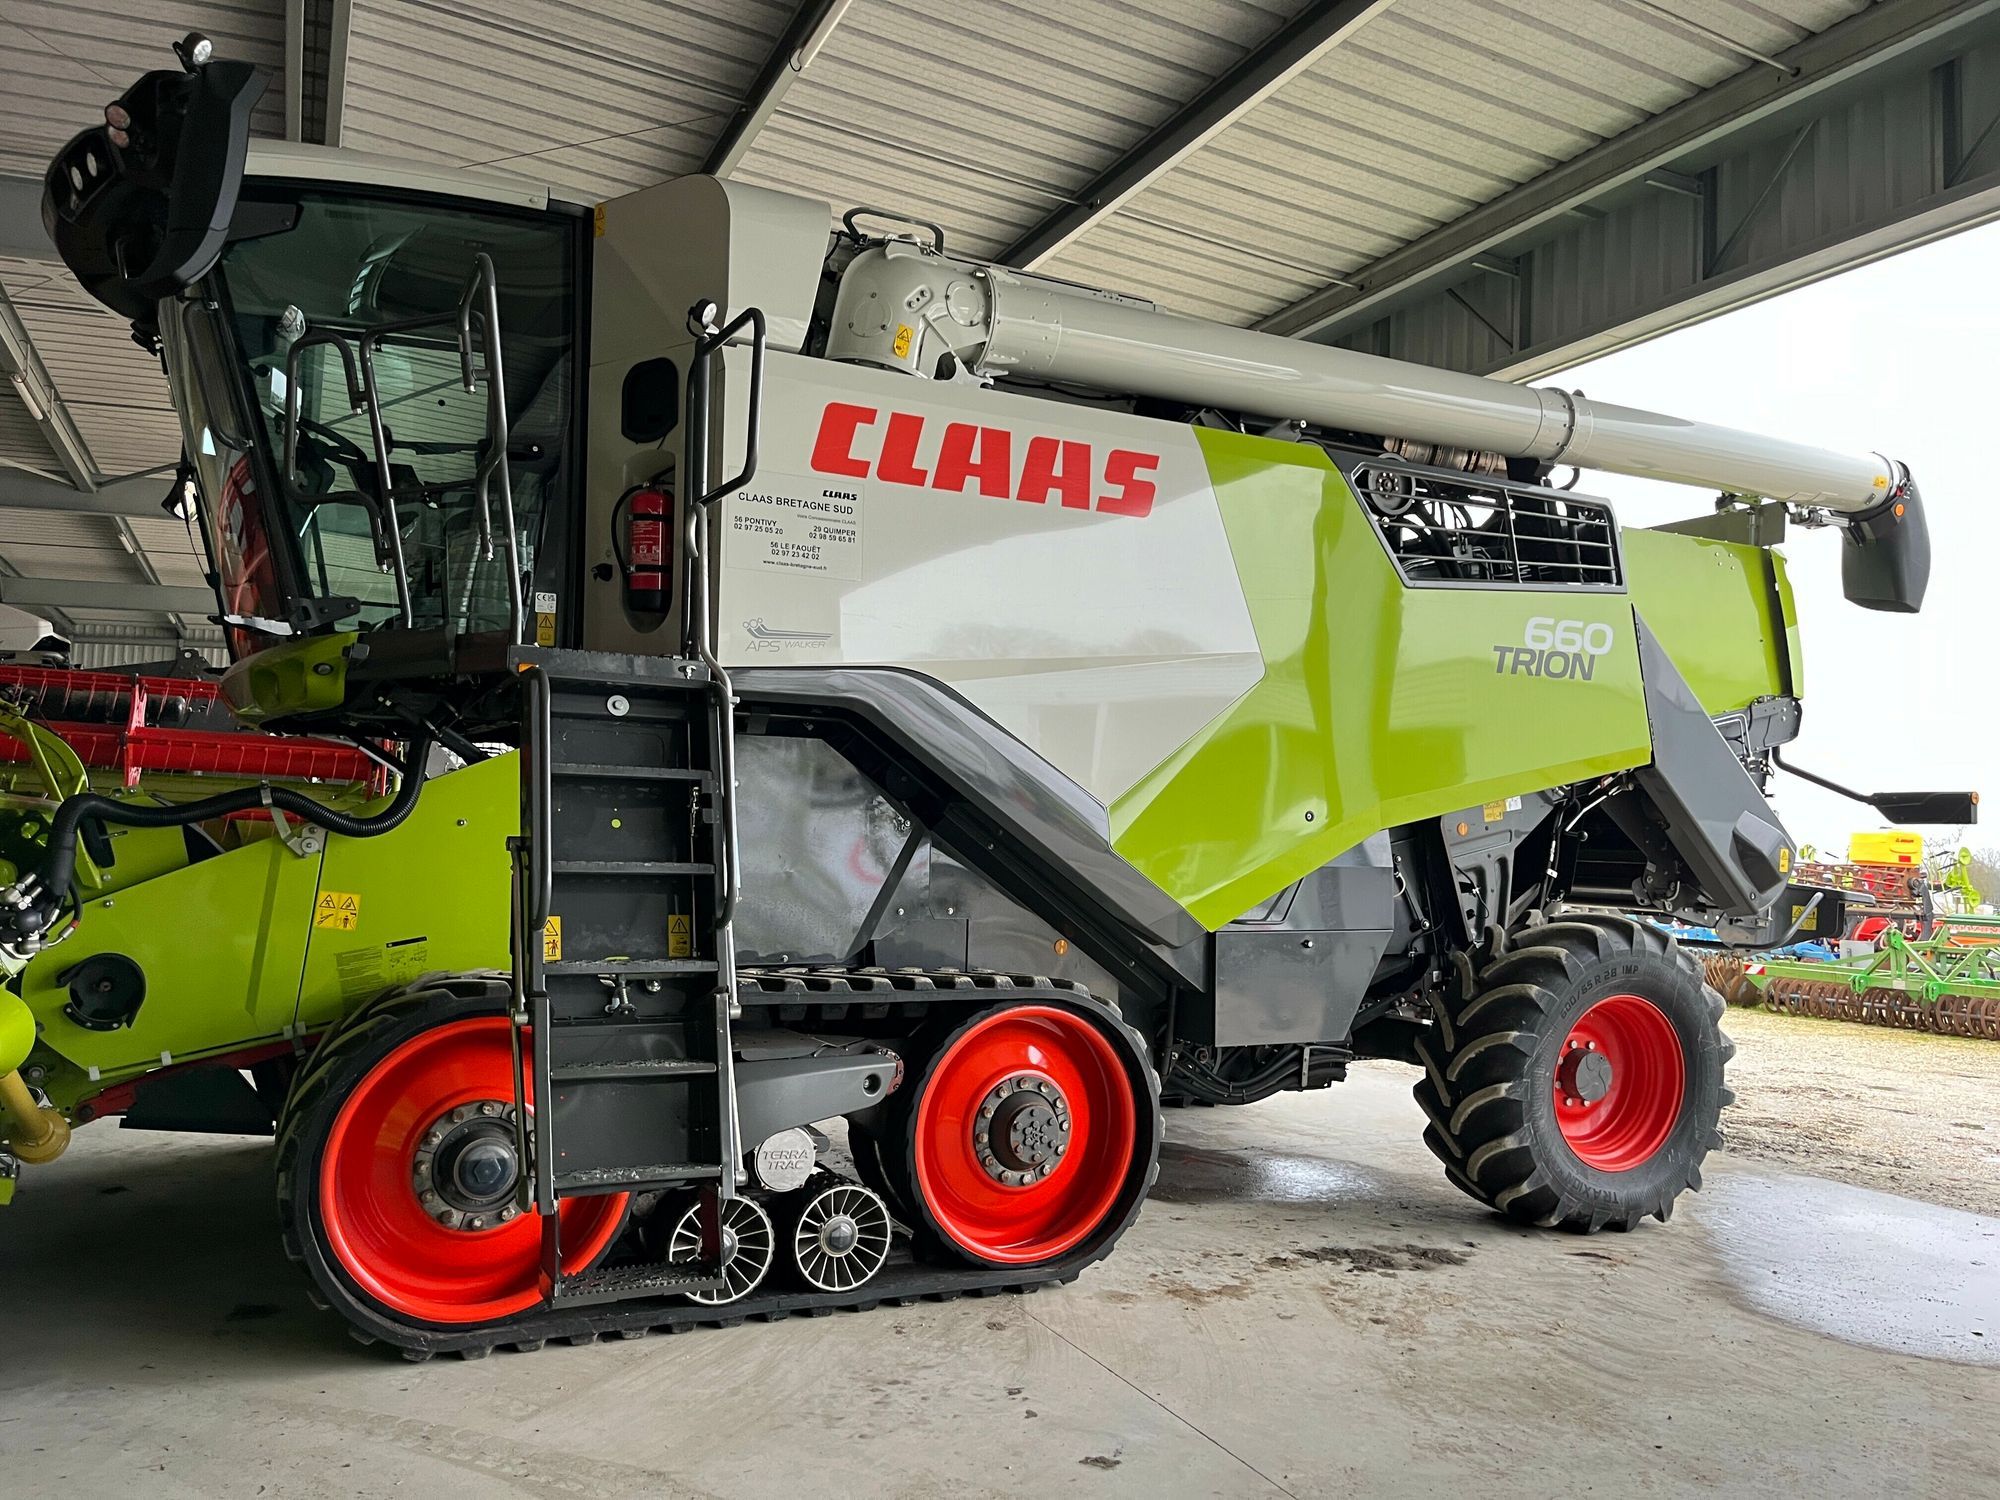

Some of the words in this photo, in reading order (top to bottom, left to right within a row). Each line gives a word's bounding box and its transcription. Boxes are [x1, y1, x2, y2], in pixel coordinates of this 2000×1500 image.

[810, 401, 1160, 518] CLAAS
[822, 490, 858, 501] CLAAS
[738, 492, 773, 504] CLAAS
[776, 497, 831, 512] BRETAGNE
[833, 504, 854, 515] SUD
[744, 517, 777, 527] PONTIVY
[754, 525, 763, 533] 25
[764, 526, 774, 534] 05
[813, 525, 822, 533] 29
[823, 527, 856, 537] QUIMPER
[770, 541, 779, 549] 56
[780, 542, 790, 550] LE
[771, 548, 780, 556] 02
[781, 549, 790, 557] 97
[1524, 616, 1614, 655] 660
[744, 640, 781, 653] APS
[784, 641, 827, 649] WALKER
[1493, 645, 1596, 681] TRION
[1594, 974, 1602, 985] R
[1604, 968, 1617, 980] 28
[1622, 965, 1639, 975] IMP
[763, 1149, 808, 1160] TERRA
[768, 1160, 805, 1170] TRAC
